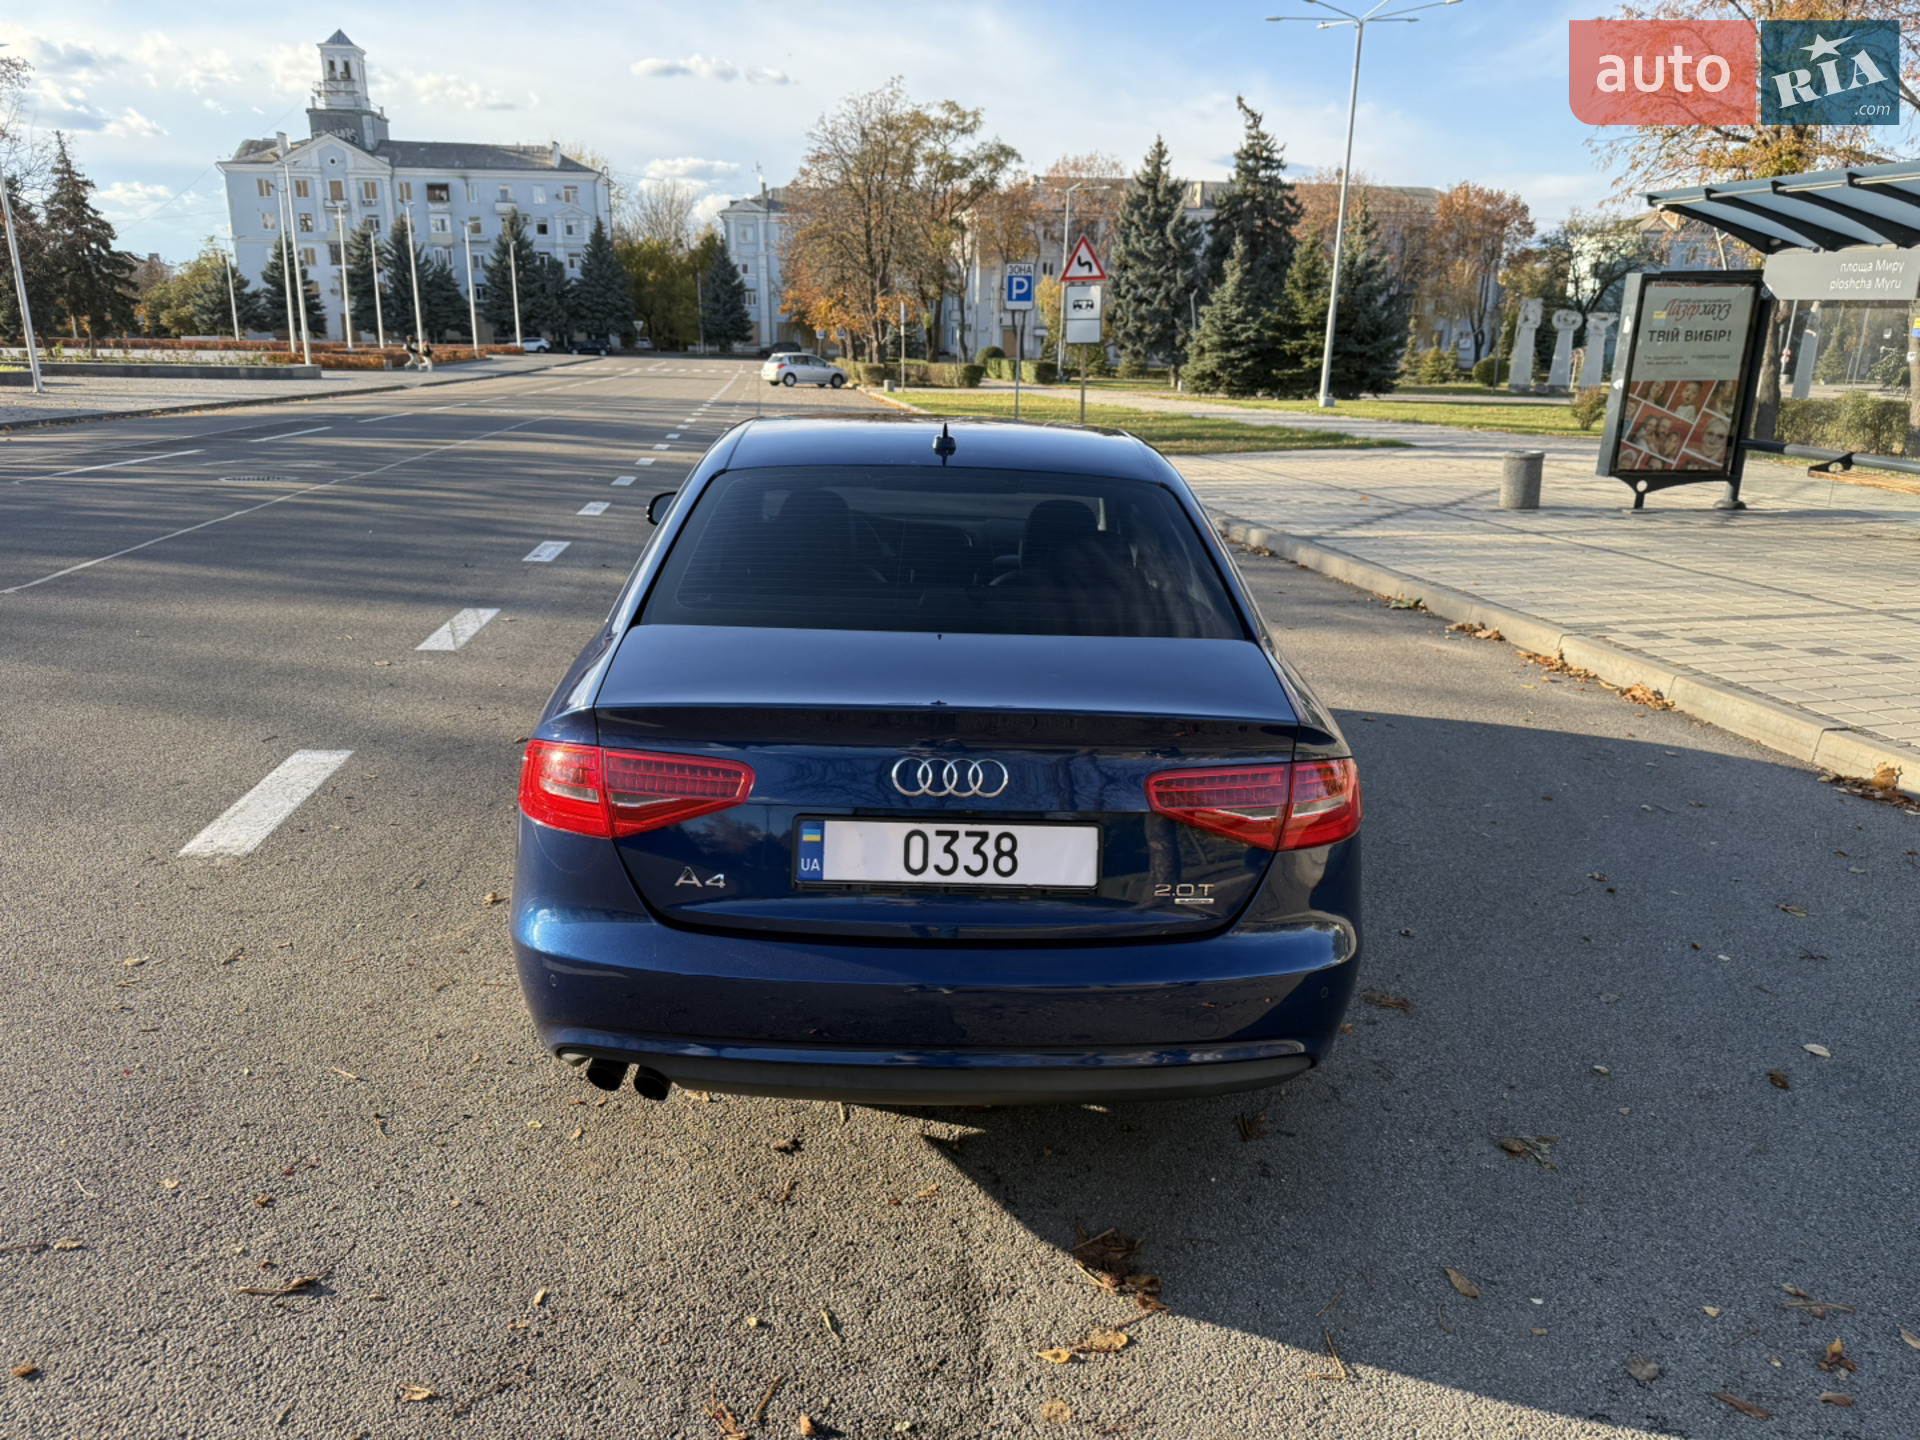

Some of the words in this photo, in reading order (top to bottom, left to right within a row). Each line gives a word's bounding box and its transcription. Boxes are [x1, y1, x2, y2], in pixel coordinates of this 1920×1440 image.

[1008, 265, 1032, 275] ЗОНА
[1840, 261, 1873, 274] площа
[1875, 259, 1905, 274] Миру
[1829, 277, 1872, 291] ploshcha
[1874, 277, 1902, 291] Myru
[1648, 328, 1680, 342] ТВІЙ
[1684, 330, 1731, 342] ВИБІР!
[800, 858, 820, 871] UA
[904, 829, 1018, 877] 0338
[674, 866, 726, 889] A4
